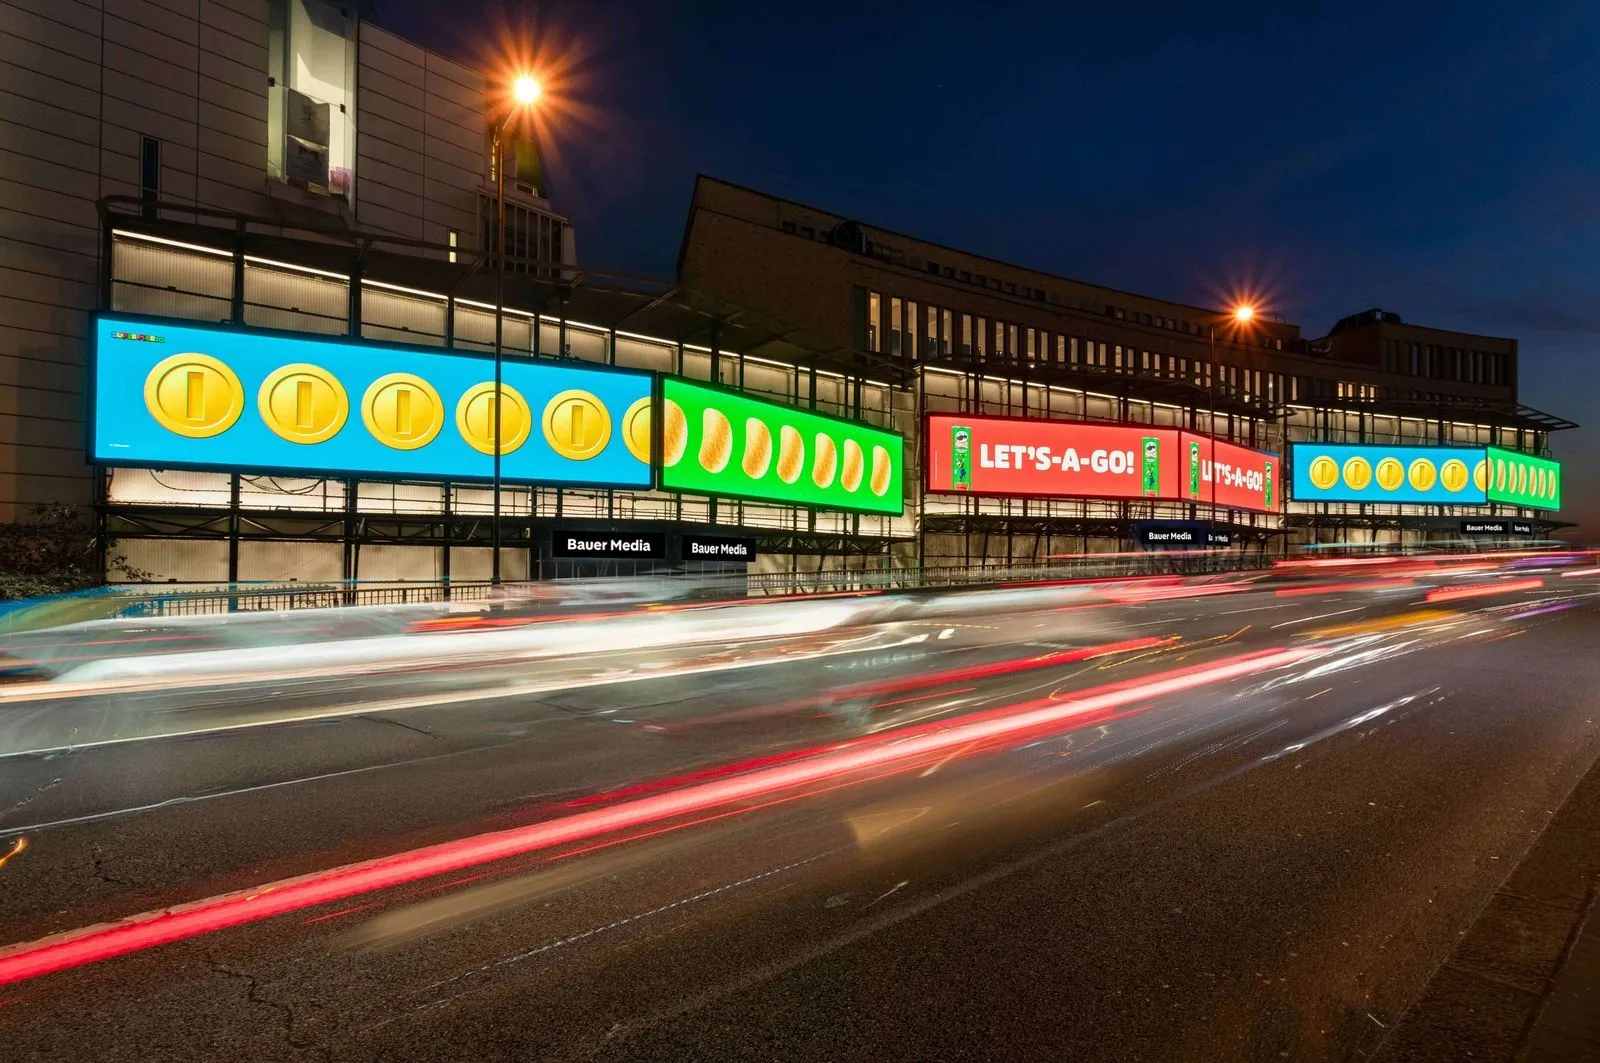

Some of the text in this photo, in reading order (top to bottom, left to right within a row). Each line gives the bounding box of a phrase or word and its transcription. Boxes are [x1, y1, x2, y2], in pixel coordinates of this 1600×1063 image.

[980, 443, 1134, 474] LET'S-A-GO!
[1466, 524, 1503, 532] Bauer Media
[1148, 531, 1192, 540] Bauer Media
[567, 538, 651, 552] Bauer Media
[691, 542, 747, 555] Bauer Media
